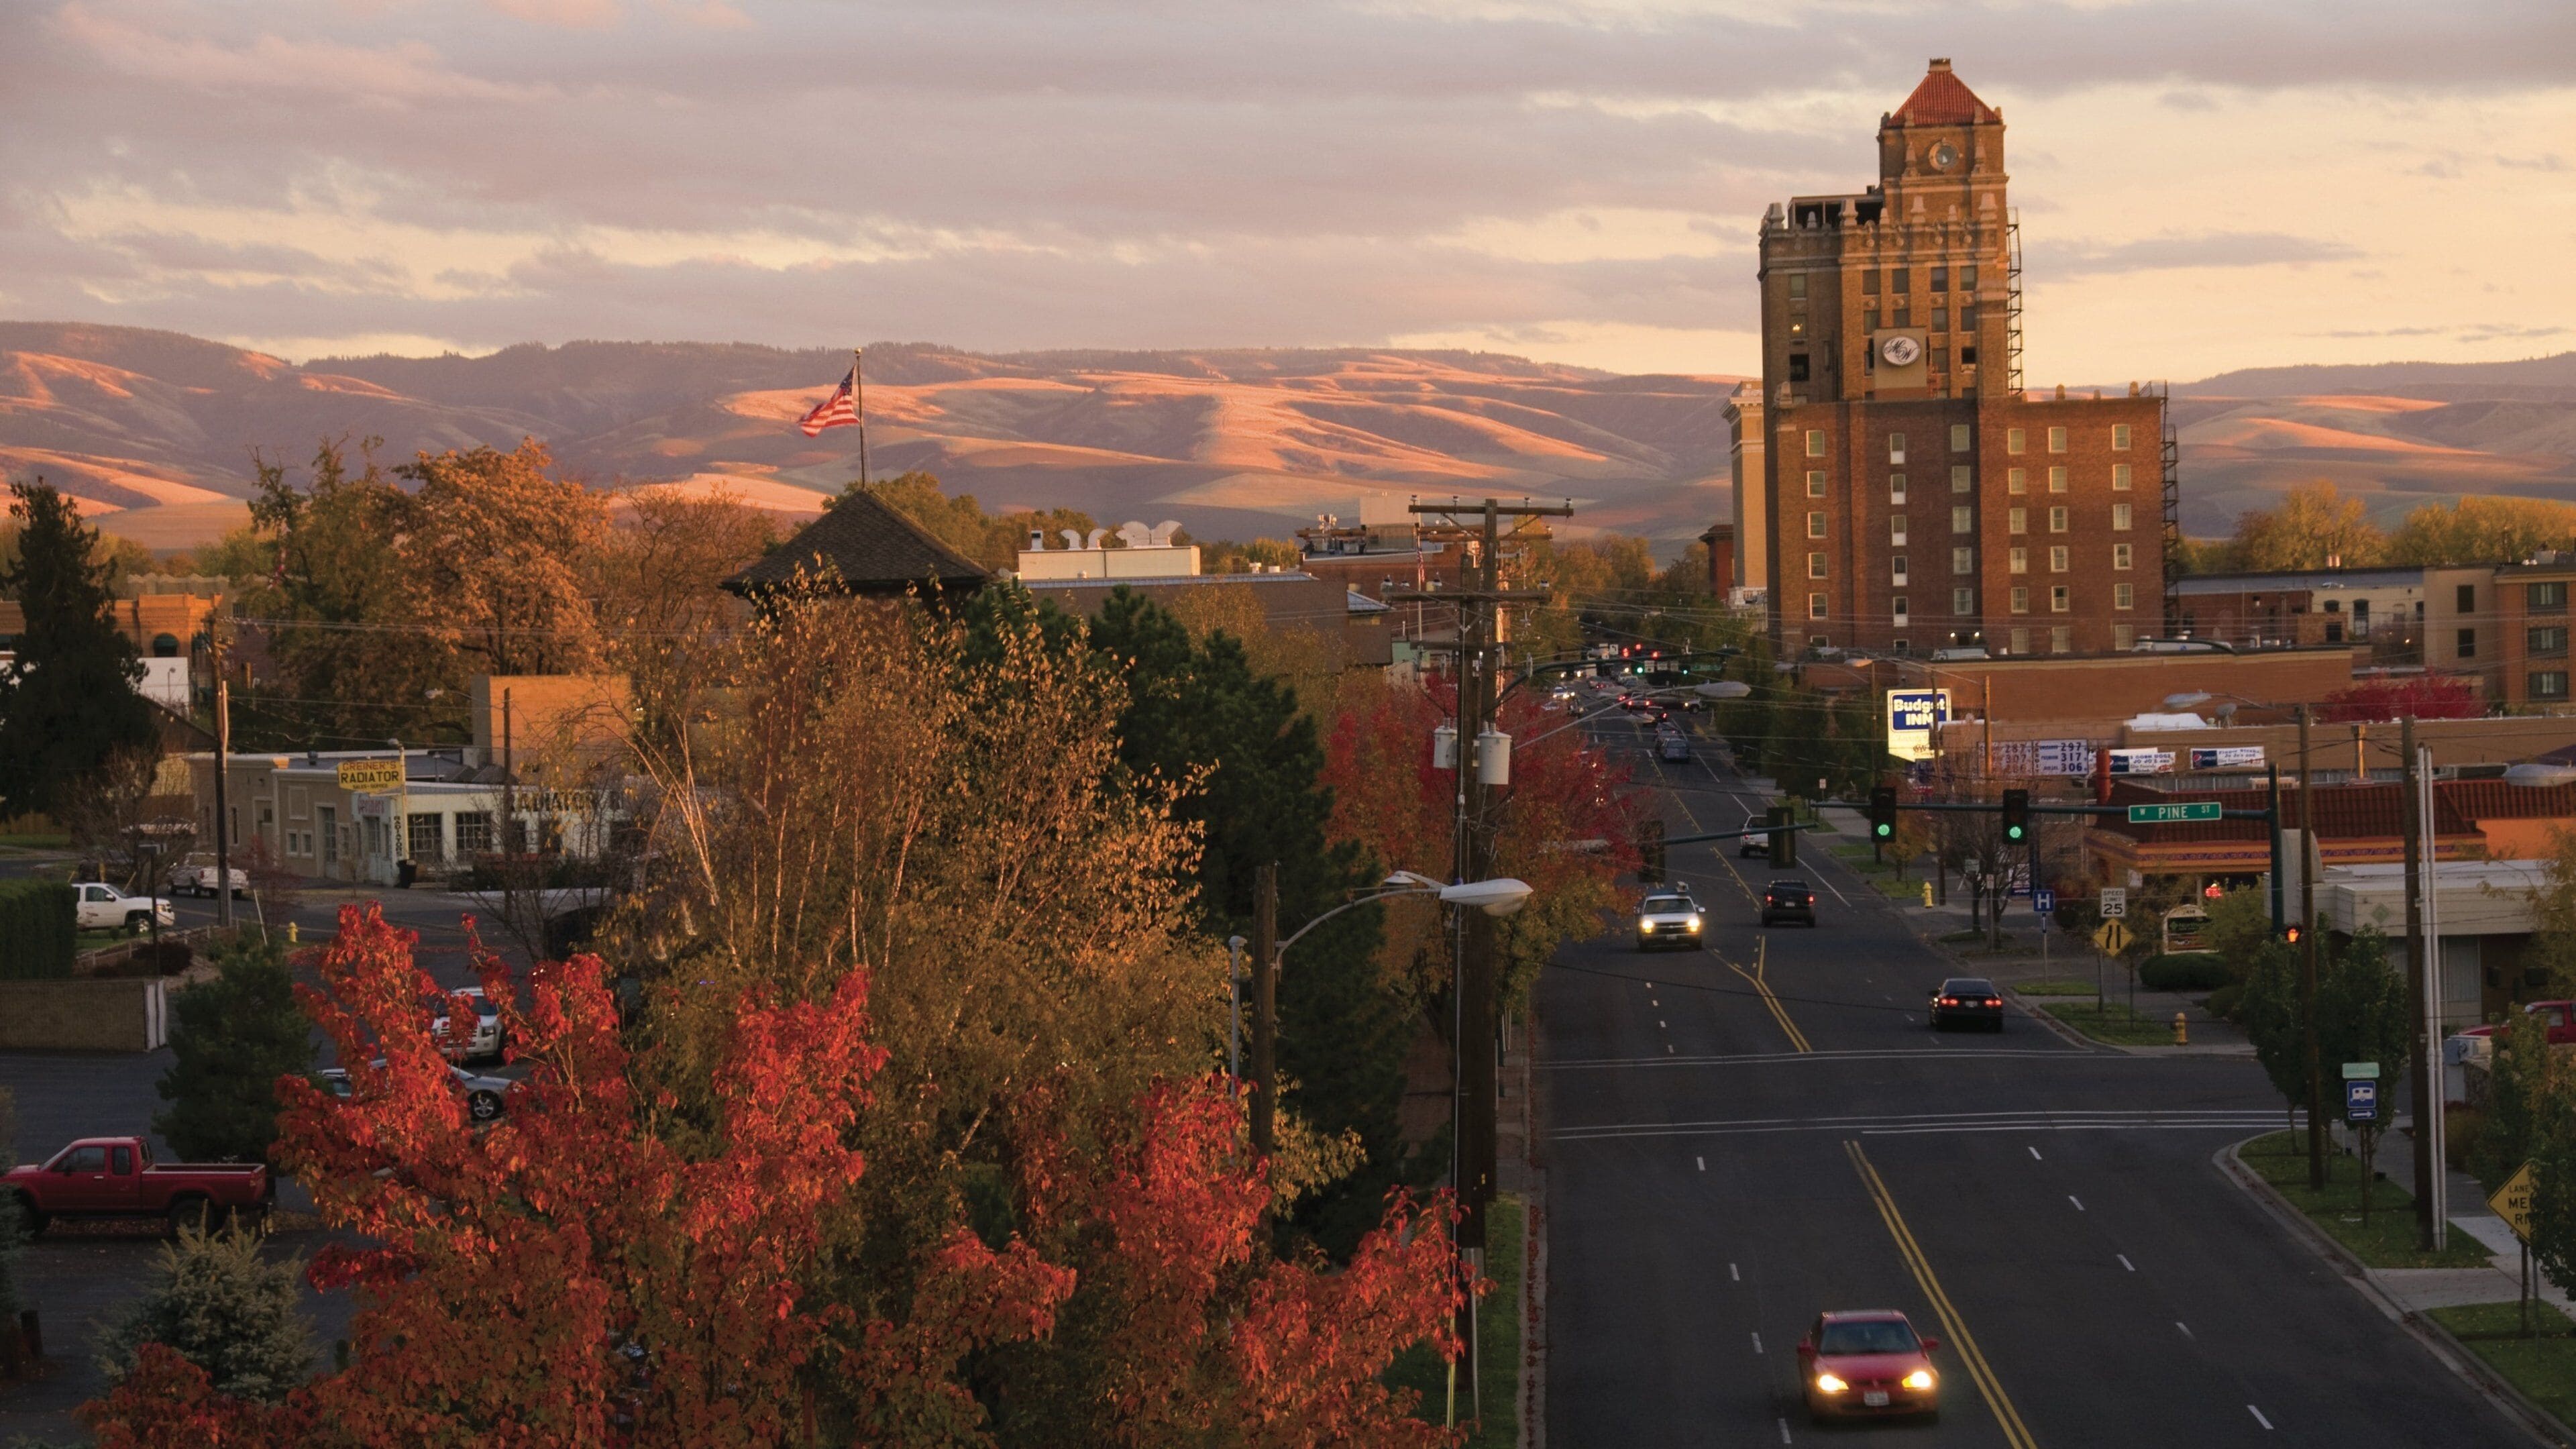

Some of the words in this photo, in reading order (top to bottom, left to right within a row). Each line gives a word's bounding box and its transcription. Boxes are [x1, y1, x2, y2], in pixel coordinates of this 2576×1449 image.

[1905, 712, 1934, 726] INN
[2061, 752, 2082, 762] 317
[342, 761, 396, 771] GREINER'S
[2061, 762, 2083, 772] 306
[340, 771, 399, 784] RADIATOR
[2139, 808, 2146, 816] W
[2158, 806, 2188, 819] PINE
[2201, 805, 2210, 814] ST
[2037, 893, 2050, 909] H
[2103, 903, 2123, 914] 25
[2509, 1185, 2529, 1193] LANE
